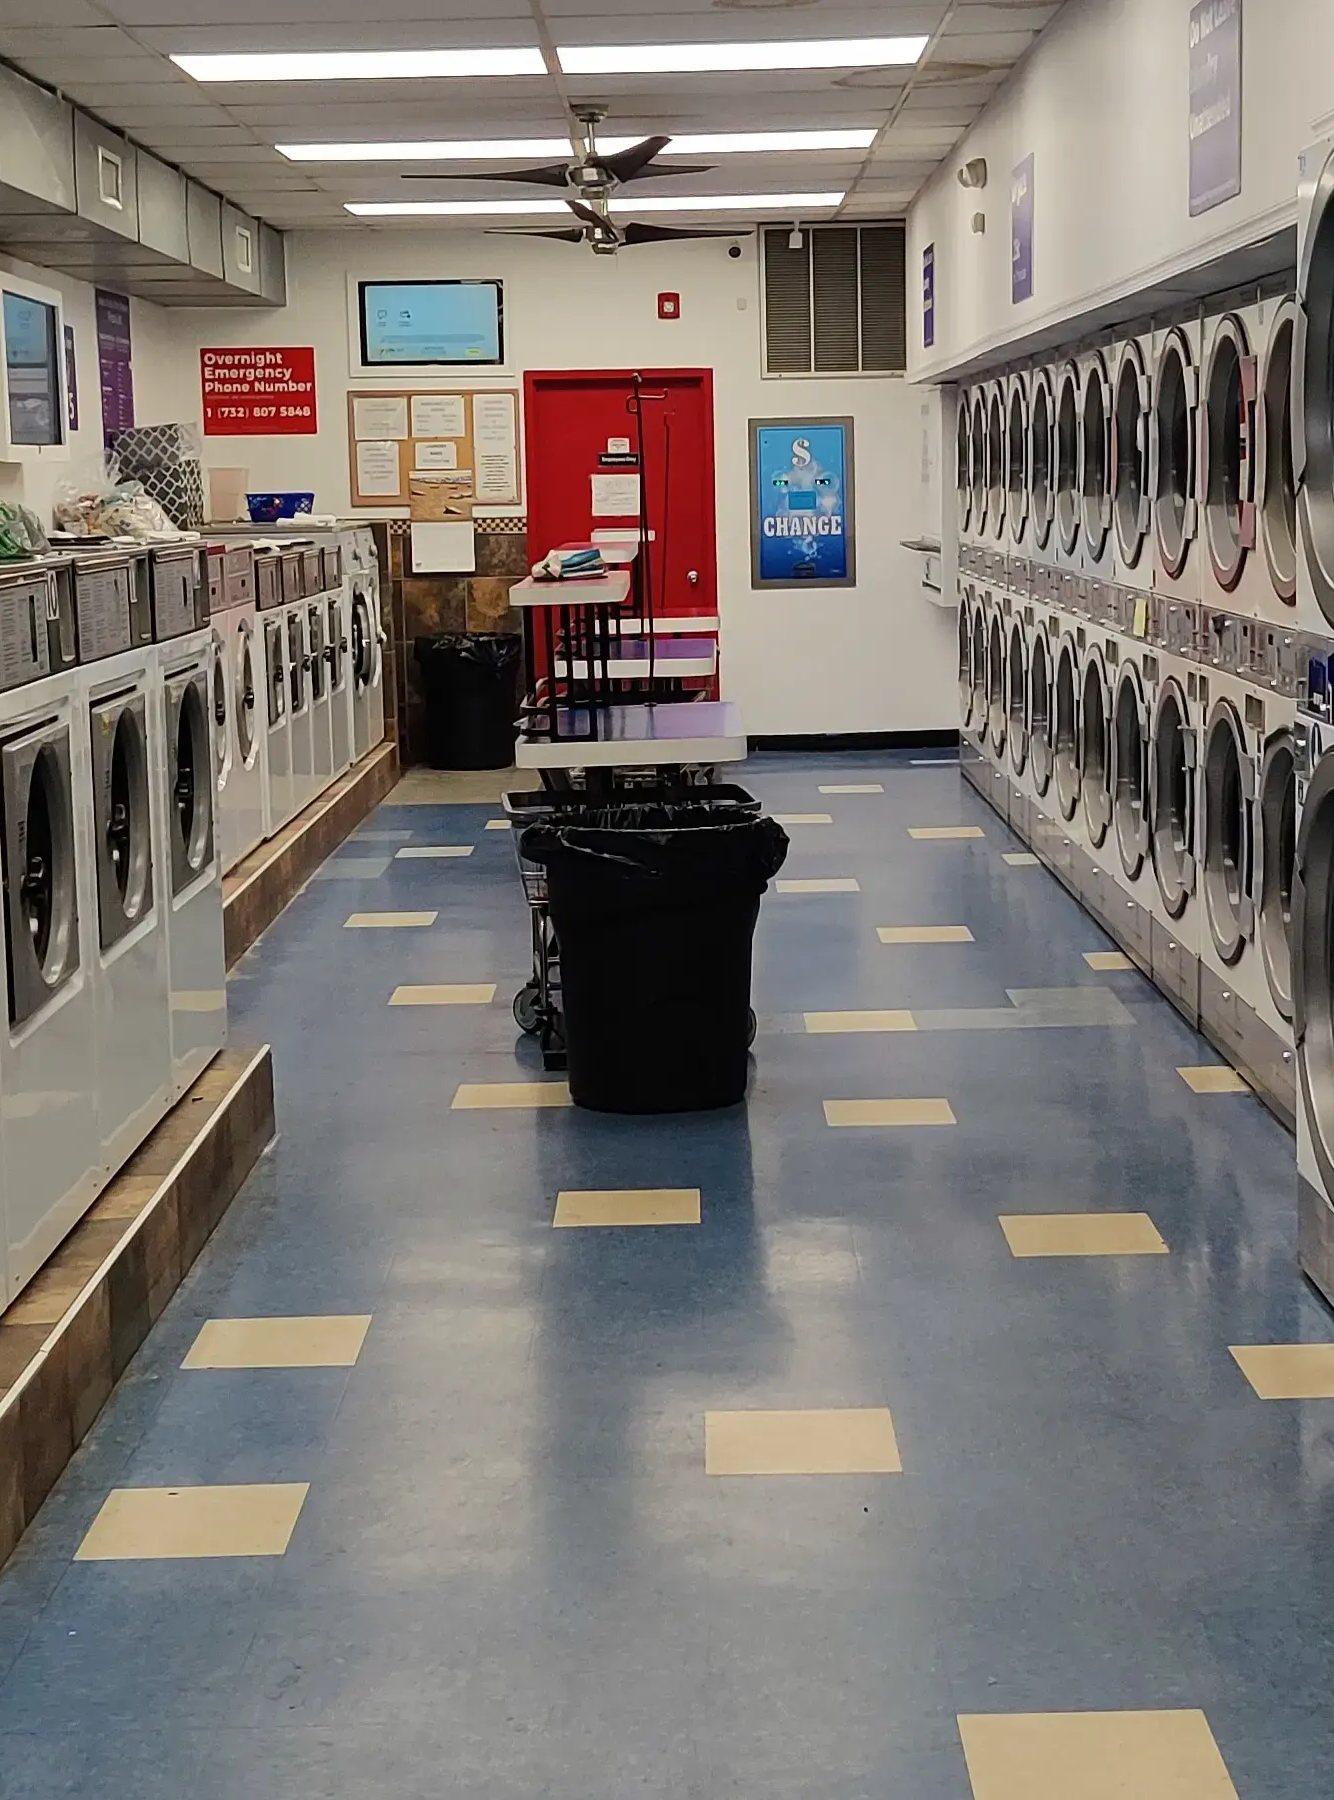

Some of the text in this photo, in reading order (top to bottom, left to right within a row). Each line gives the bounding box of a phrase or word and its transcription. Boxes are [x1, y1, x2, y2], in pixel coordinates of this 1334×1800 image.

[204, 352, 283, 366] Overnight
[204, 367, 292, 381] Emergency
[205, 380, 312, 393] Phone Number
[206, 406, 311, 419] 1 (732) 807 5848
[763, 515, 842, 537] CHANGE
